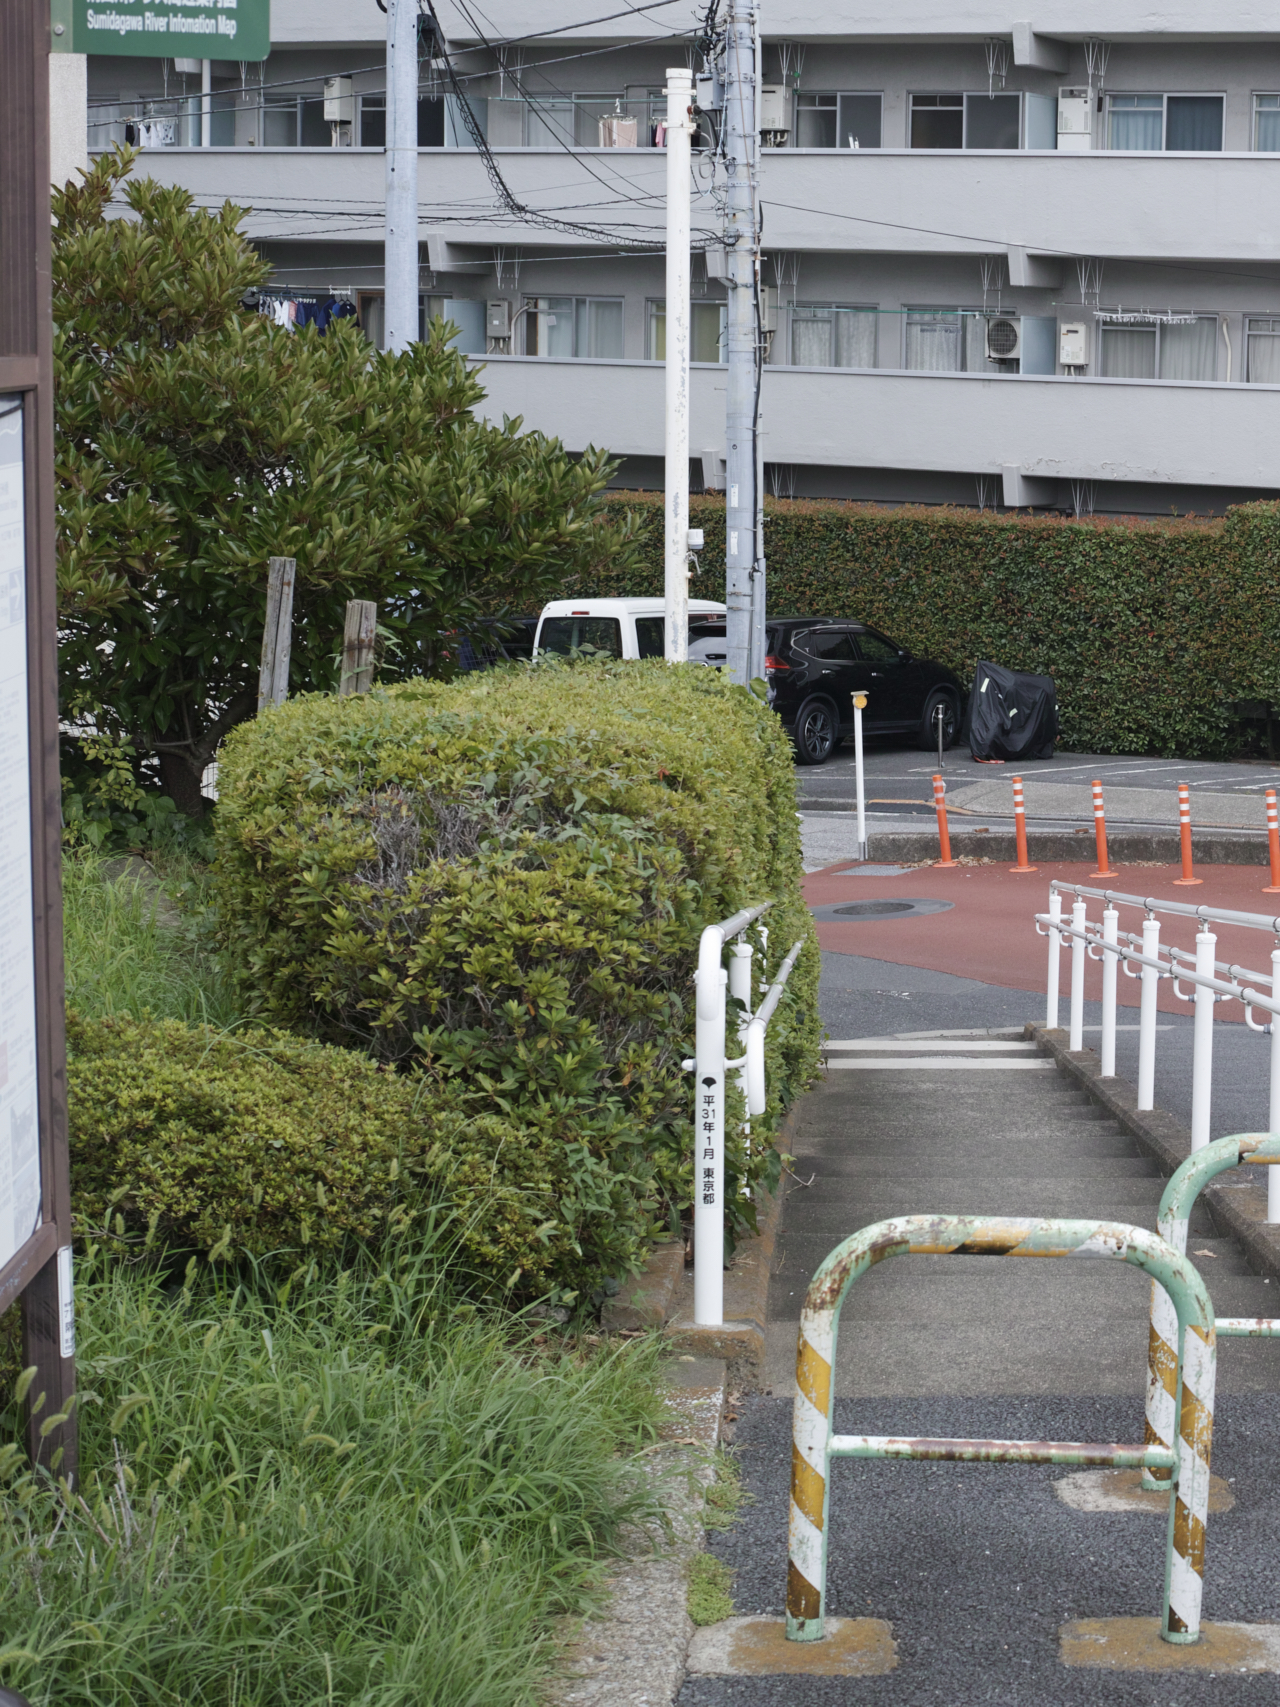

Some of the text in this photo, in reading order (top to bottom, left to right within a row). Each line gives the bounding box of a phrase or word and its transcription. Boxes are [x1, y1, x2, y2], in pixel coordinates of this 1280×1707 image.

[87, 9, 143, 35] Sumidagawa
[144, 11, 168, 32] River
[217, 15, 237, 39] Map
[701, 1095, 716, 1205] 平31年1月 東京都
